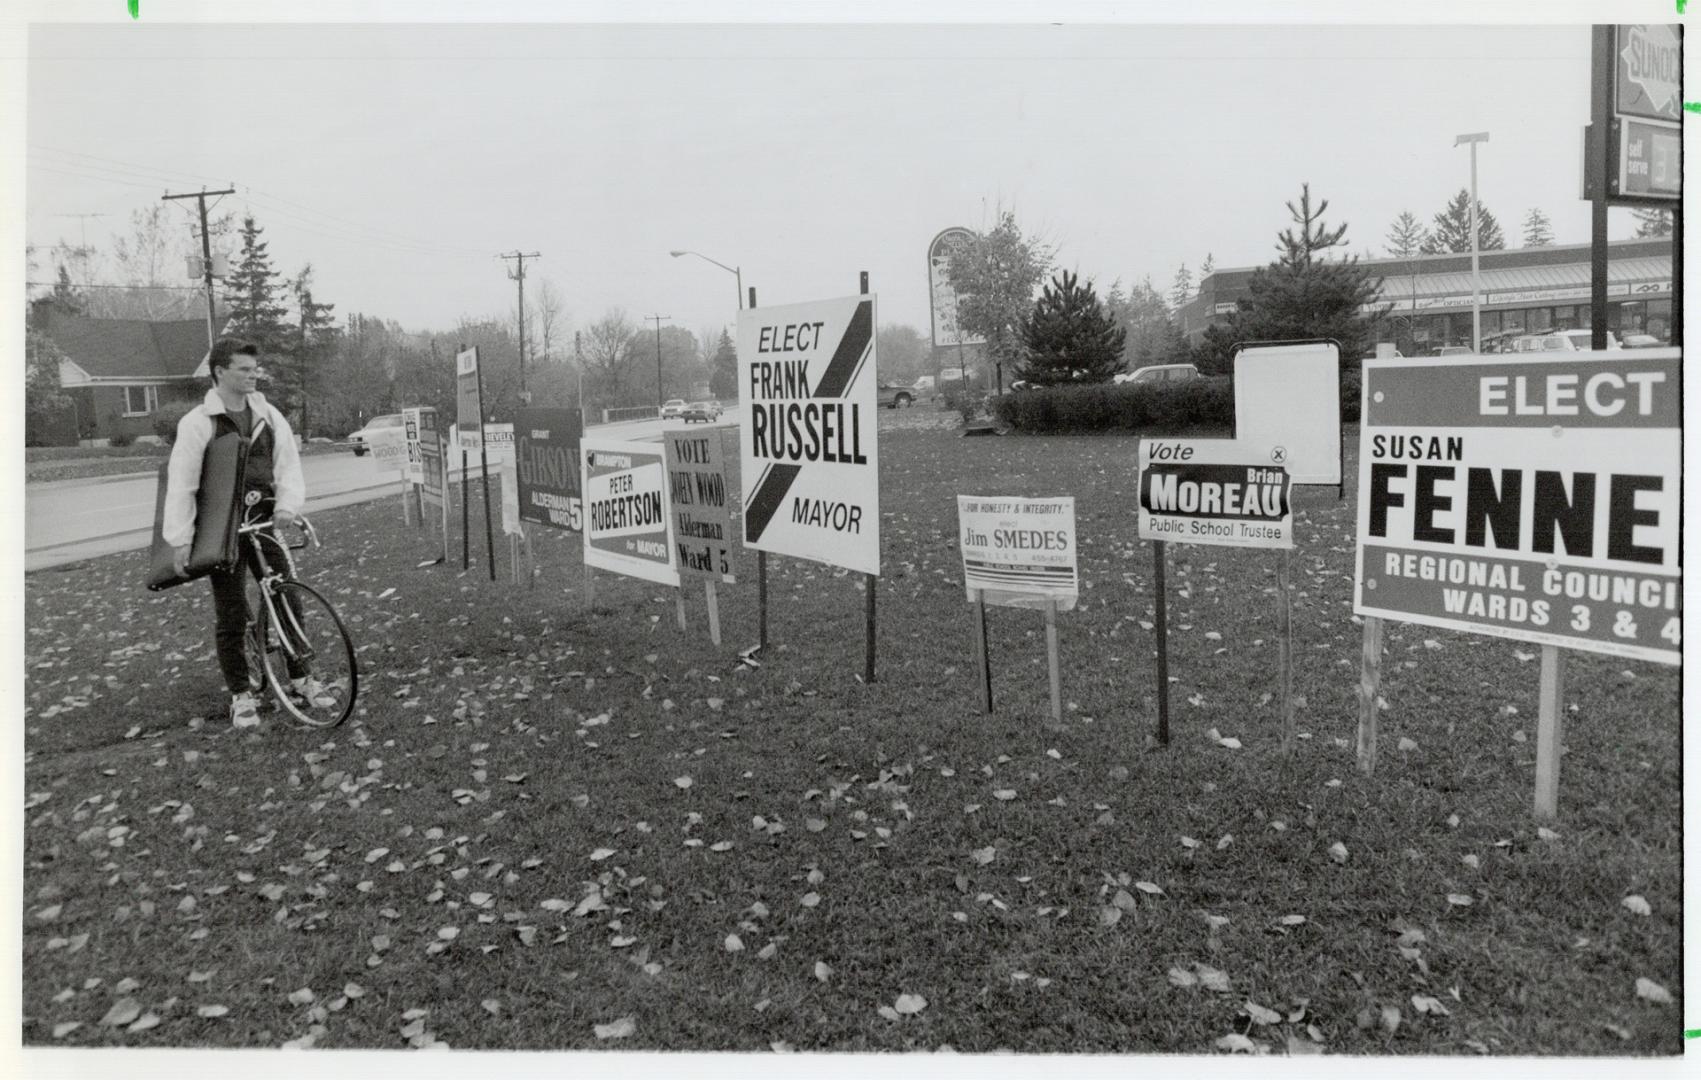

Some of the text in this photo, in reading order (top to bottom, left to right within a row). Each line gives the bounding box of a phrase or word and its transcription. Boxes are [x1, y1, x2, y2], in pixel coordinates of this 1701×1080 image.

[758, 321, 824, 353] ELECT
[751, 359, 811, 400] FRANK
[1479, 372, 1666, 416] ELECT
[752, 403, 867, 465] RUSSELL
[1372, 434, 1463, 461] SUSAN
[674, 438, 711, 464] VOTE
[1149, 443, 1194, 461] Vote
[609, 474, 633, 494] PETER
[695, 471, 725, 507] WOOD
[1247, 467, 1284, 485] Brian
[531, 491, 571, 511] ALDERMAN
[591, 490, 663, 531] ROBERTSON
[980, 503, 1012, 514] HONESTY
[1014, 503, 1020, 514] &
[1150, 473, 1282, 517] MOREAU
[549, 498, 582, 530] WARD 5
[679, 512, 724, 541] Alderman
[792, 497, 862, 534] MAYOR
[1149, 517, 1282, 539] Public School Trustee
[1368, 462, 1664, 566] FENNE
[637, 540, 667, 558] MAYOR
[965, 528, 1068, 551] Jim SMEDES
[678, 543, 729, 574] Ward 5
[1385, 553, 1526, 592] REGIONAL
[1543, 568, 1677, 611] COUNCI
[1443, 588, 1550, 626] WARDS
[1570, 605, 1591, 632] 3
[1612, 610, 1637, 639] &
[1661, 616, 1681, 646] 4
